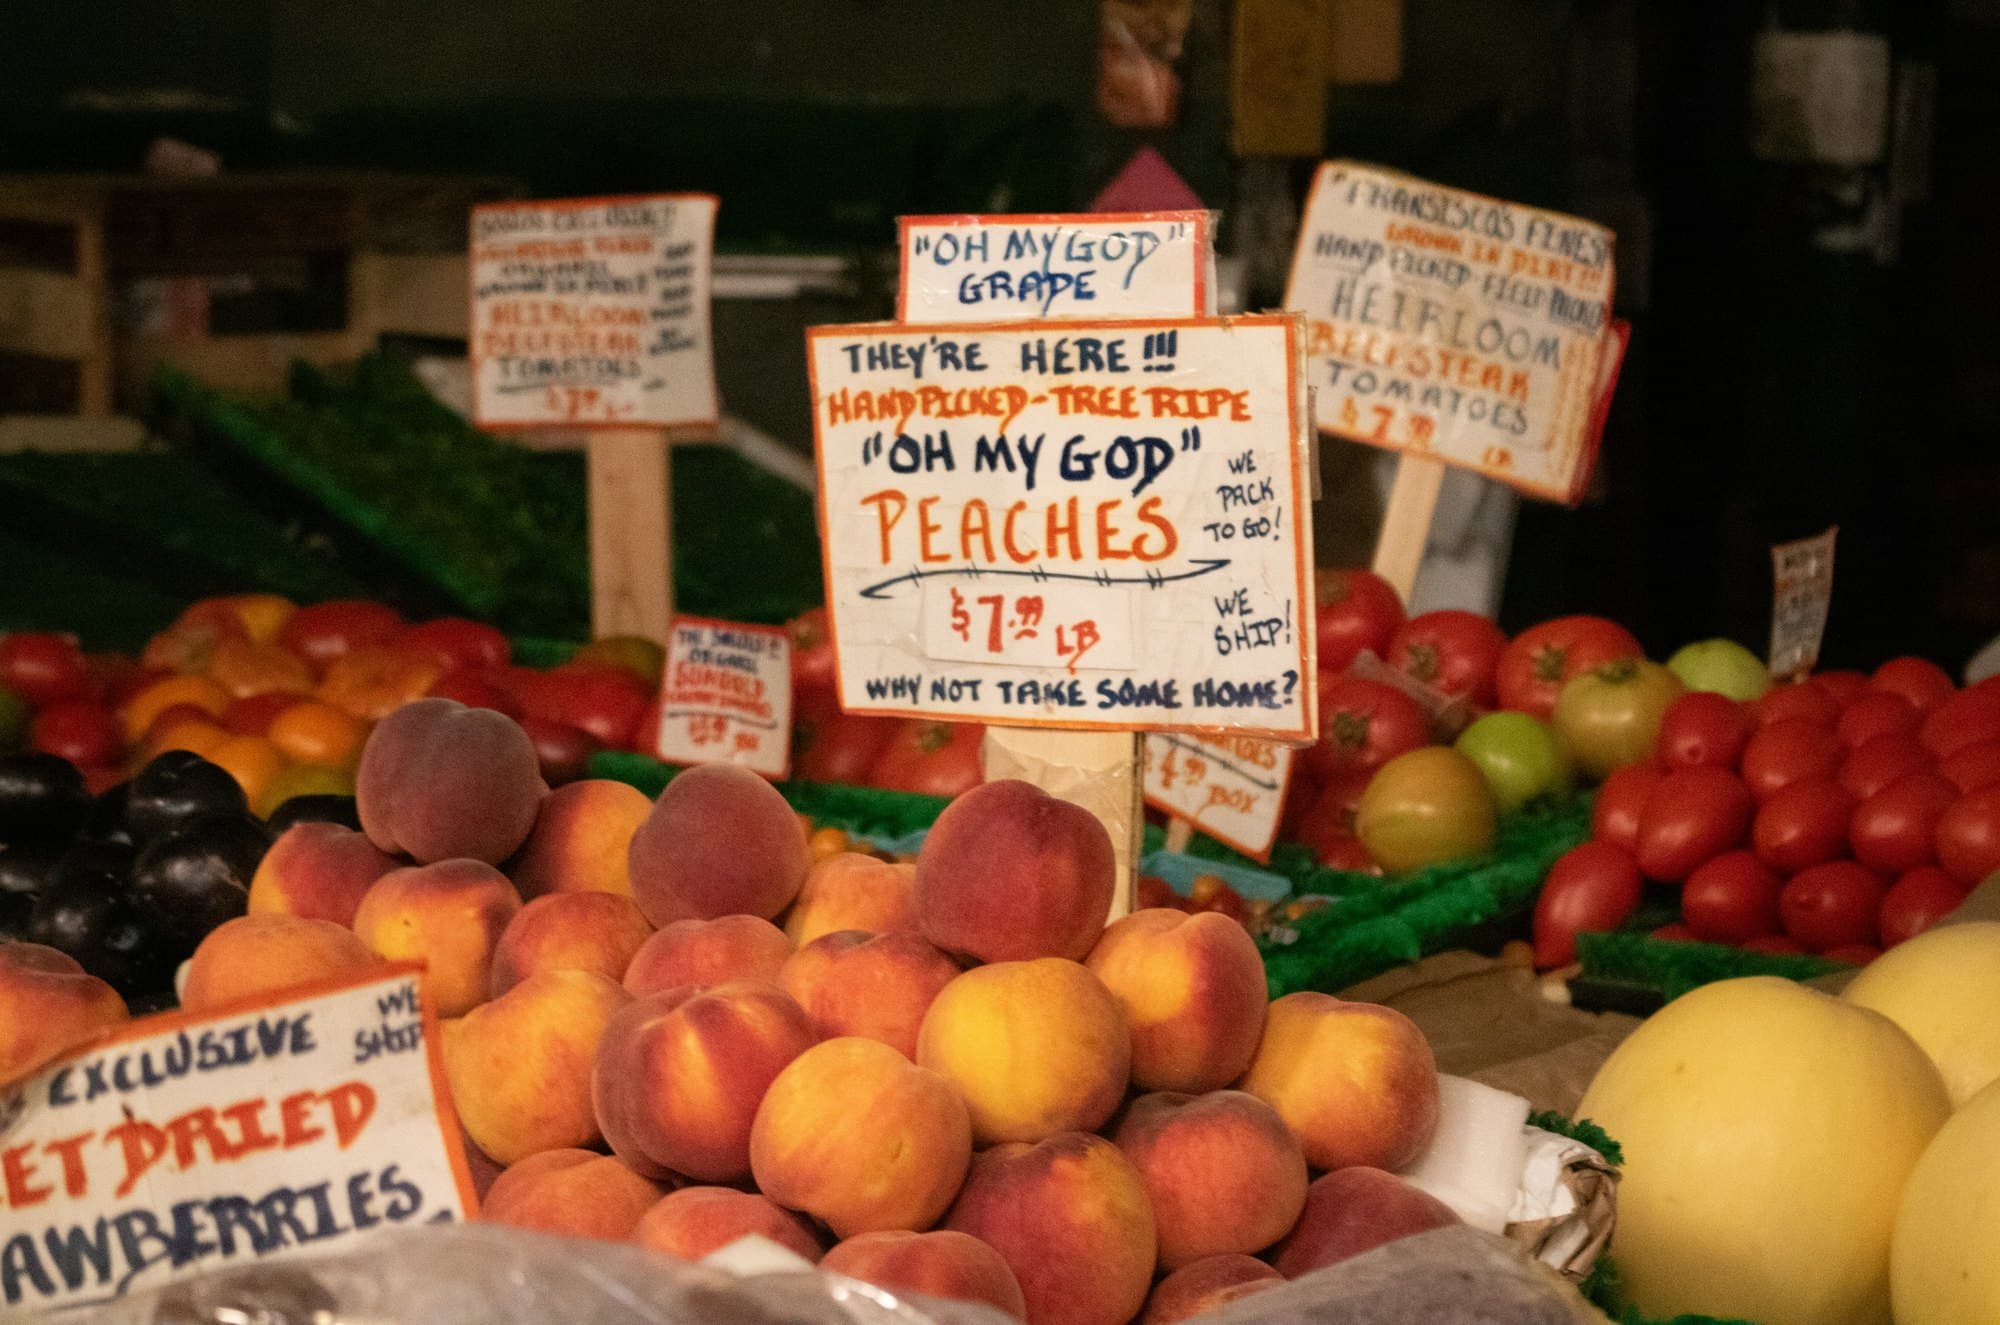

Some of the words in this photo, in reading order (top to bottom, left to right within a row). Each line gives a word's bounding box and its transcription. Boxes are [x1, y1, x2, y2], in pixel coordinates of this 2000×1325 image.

[914, 229, 988, 266] "OH
[1003, 226, 1066, 280] MY
[1065, 222, 1186, 290] GOD"
[958, 269, 1097, 316] GRADE
[1331, 278, 1561, 371] HEIRLOOM
[841, 335, 989, 379] THEY'RE
[1020, 337, 1130, 375] HERE
[1144, 386, 1252, 423] RIPE
[1326, 358, 1528, 435] TOMATOES
[861, 430, 955, 474] "OH
[974, 433, 1046, 490] MY
[1060, 424, 1201, 497] GOD"
[1227, 449, 1257, 476] WE
[1216, 482, 1275, 511] PACK
[861, 489, 1179, 565] PEACHES
[1203, 521, 1236, 543] TO
[1242, 506, 1281, 540] GO!
[1213, 587, 1255, 619] WE
[1054, 619, 1101, 675] LB
[1213, 599, 1292, 656] SHIP!
[865, 674, 921, 705] WHY
[930, 677, 982, 703] NOT
[997, 679, 1088, 708] TAKE
[1096, 676, 1183, 709] SOME
[1192, 669, 1300, 709] HOME?
[377, 982, 420, 1017] WE
[48, 1012, 317, 1107] EXCLUSIVE
[354, 1020, 424, 1063] SHIP
[0, 1131, 96, 1211] ET
[105, 1080, 377, 1199] DRIED
